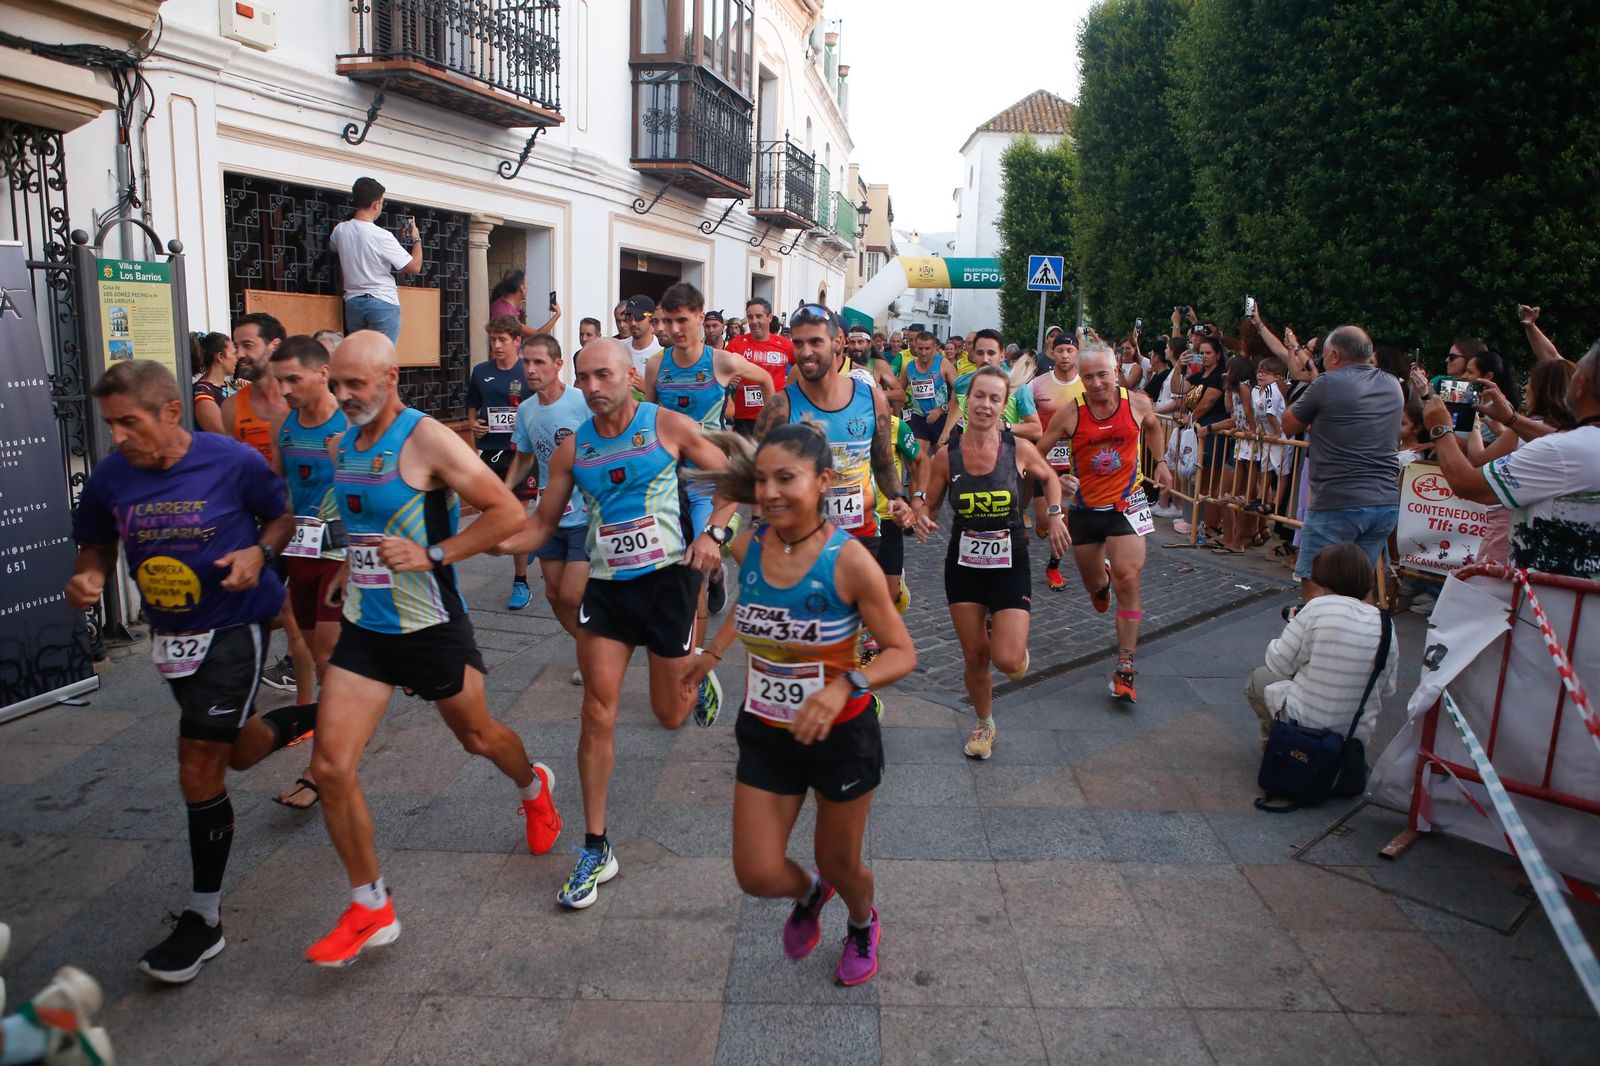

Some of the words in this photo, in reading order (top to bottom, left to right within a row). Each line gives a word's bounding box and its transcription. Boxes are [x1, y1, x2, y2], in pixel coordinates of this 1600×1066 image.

[118, 262, 133, 270] Villa
[119, 271, 134, 280] Los
[135, 272, 162, 281] Barrios
[7, 379, 44, 388] sonido
[915, 385, 929, 393] 427
[1053, 447, 1071, 458] 298
[3, 502, 47, 515] eventos
[958, 490, 1011, 514] JRP
[1428, 517, 1453, 532] Tlf:
[611, 532, 648, 554] 290
[970, 540, 1001, 556] 270
[6, 560, 27, 574] 651
[746, 606, 785, 622] TRAIL
[736, 619, 773, 637] TEAM
[162, 639, 199, 658] 132
[761, 677, 804, 705] 239
